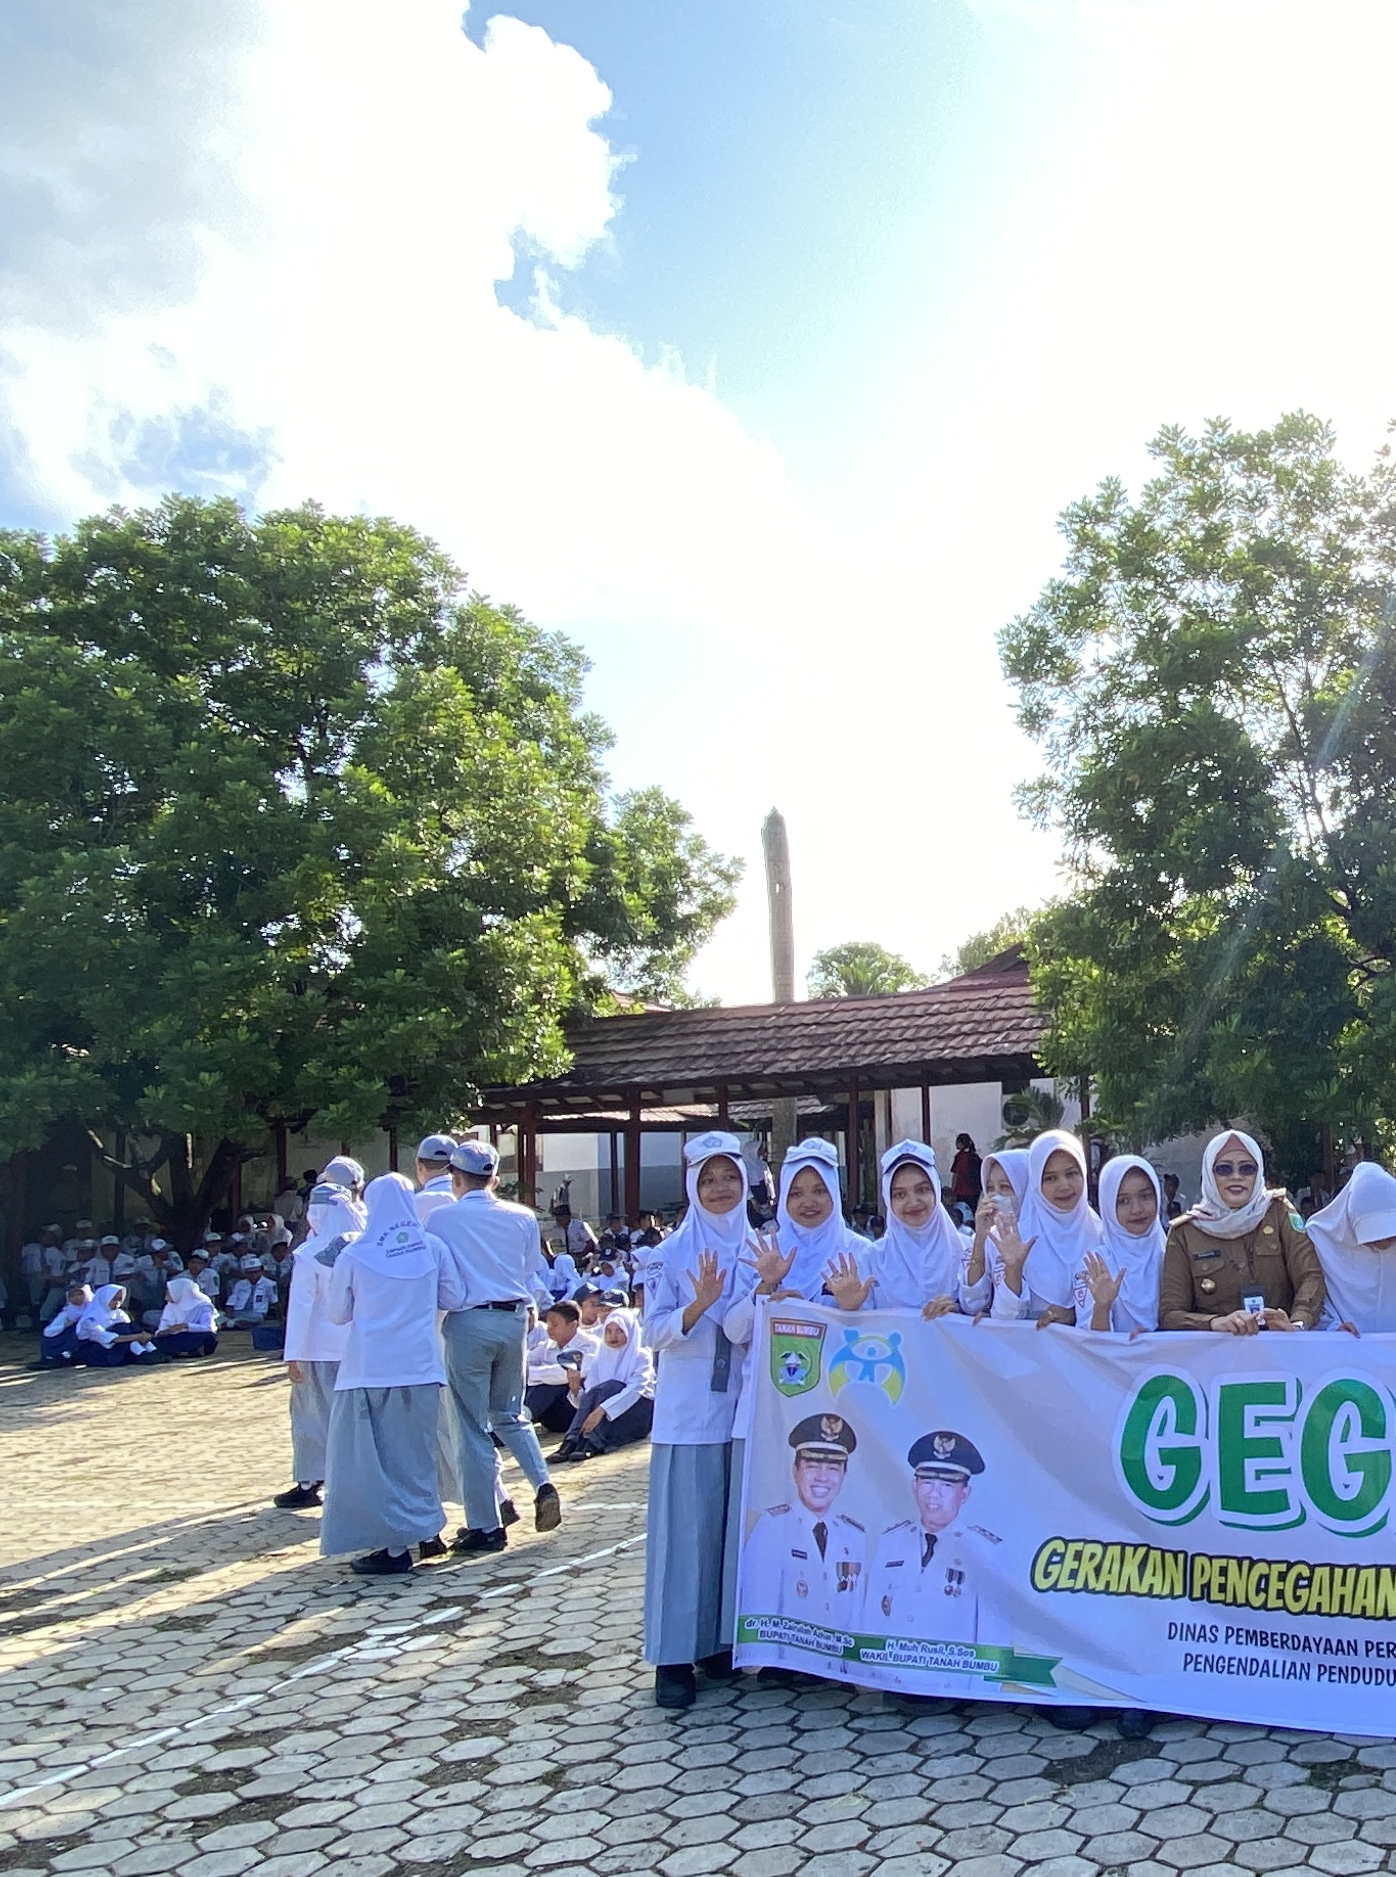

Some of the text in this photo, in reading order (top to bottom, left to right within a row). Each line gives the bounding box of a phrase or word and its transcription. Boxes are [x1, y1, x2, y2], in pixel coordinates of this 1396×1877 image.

[1031, 1537, 1187, 1599] GERAKAN
[760, 1630, 843, 1654] BUPATI TANAH BUMBU
[887, 1640, 896, 1650] H.
[899, 1641, 919, 1652] Muh
[1167, 1621, 1219, 1645] DINAS
[1224, 1625, 1359, 1657] PEMBERDAYAAN
[861, 1651, 998, 1672] WAKIL BUPATI TANAH BUMBU
[1182, 1652, 1311, 1681] PENGENDALIAN
